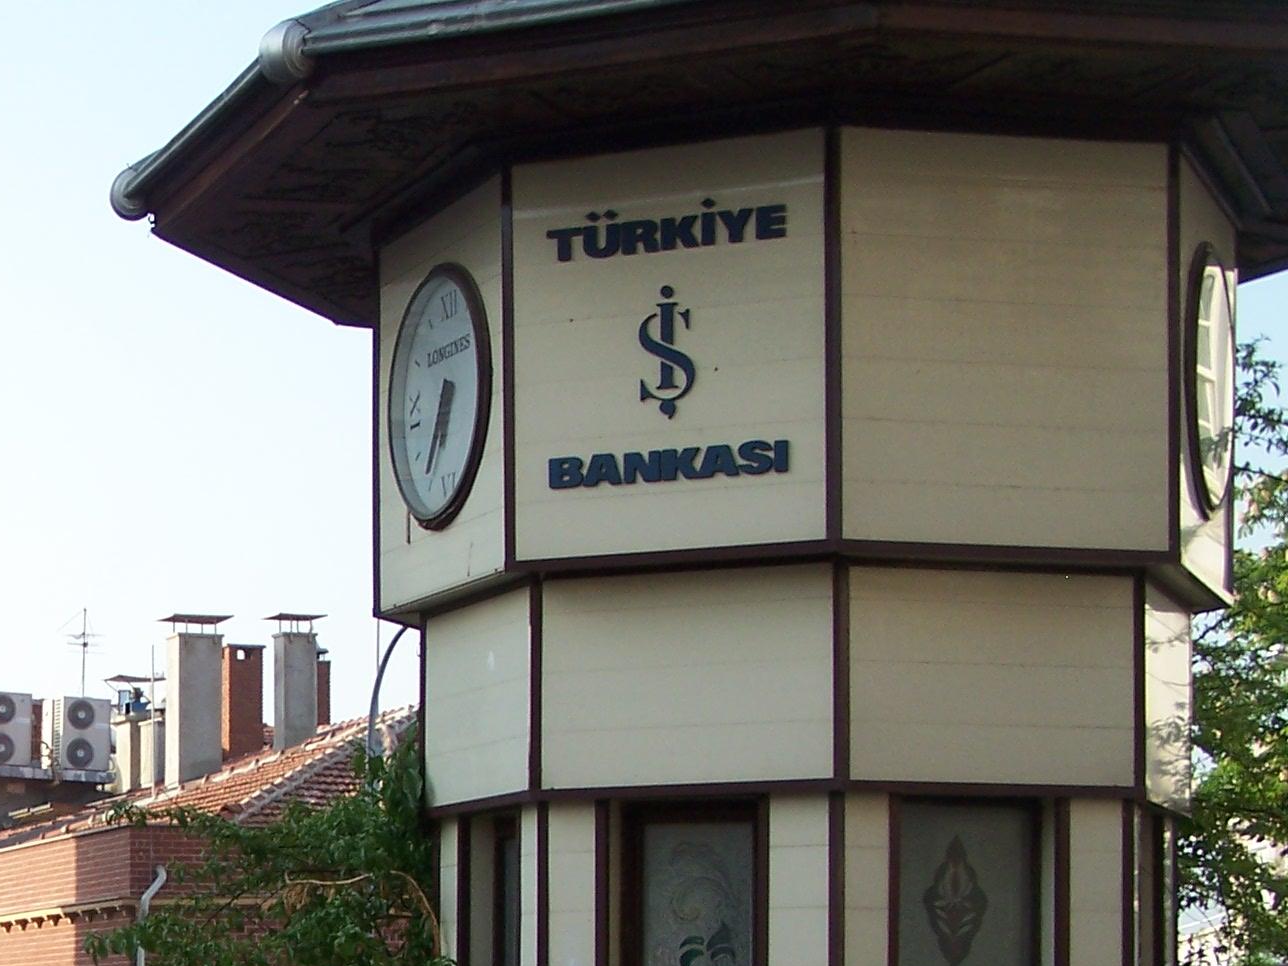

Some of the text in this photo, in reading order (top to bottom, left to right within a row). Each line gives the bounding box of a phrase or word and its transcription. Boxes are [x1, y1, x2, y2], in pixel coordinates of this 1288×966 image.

[547, 199, 789, 263] TÜRKİYE
[426, 333, 472, 368] LONGINES
[549, 439, 790, 490] BANKASI
